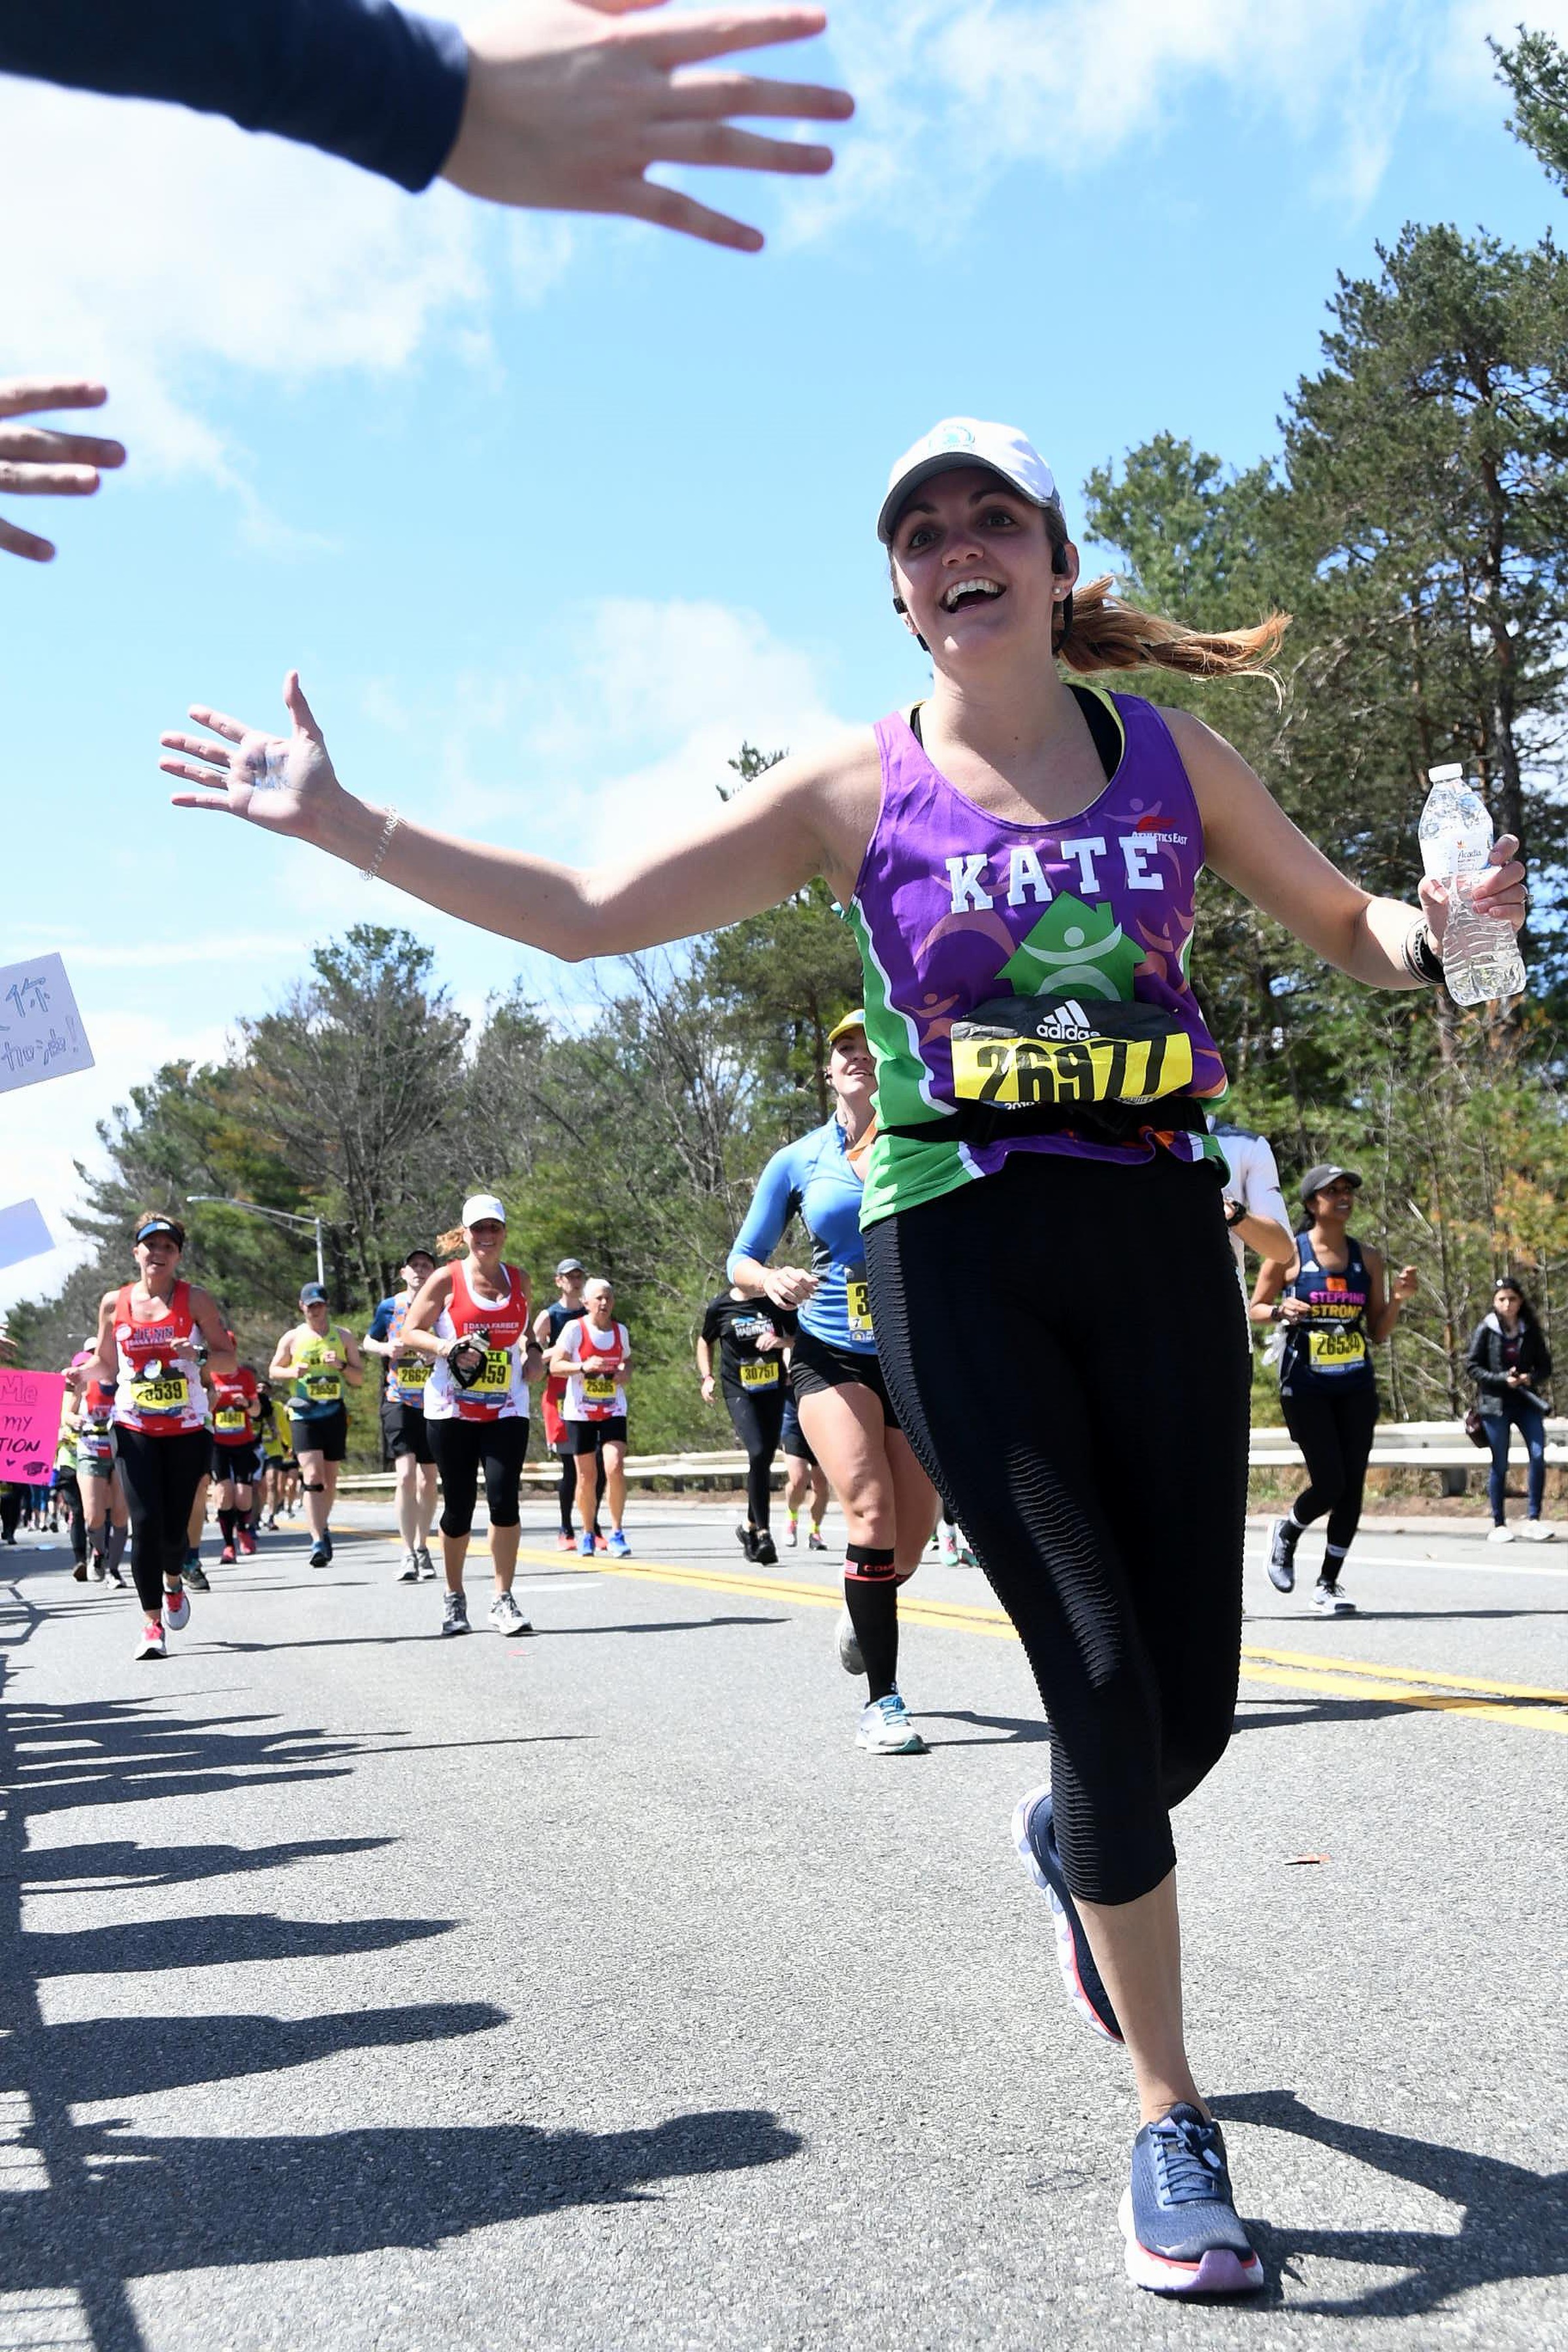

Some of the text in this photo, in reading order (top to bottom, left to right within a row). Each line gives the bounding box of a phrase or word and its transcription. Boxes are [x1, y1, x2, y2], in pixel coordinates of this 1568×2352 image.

[945, 836, 1164, 914] KATE
[977, 1036, 1168, 1103] 26977
[1309, 1291, 1365, 1305] STEPPING
[134, 1326, 174, 1340] JENN
[401, 1369, 432, 1383] 2662
[745, 1365, 775, 1380] 30751
[0, 1375, 38, 1403] Me
[137, 1382, 183, 1402] 539
